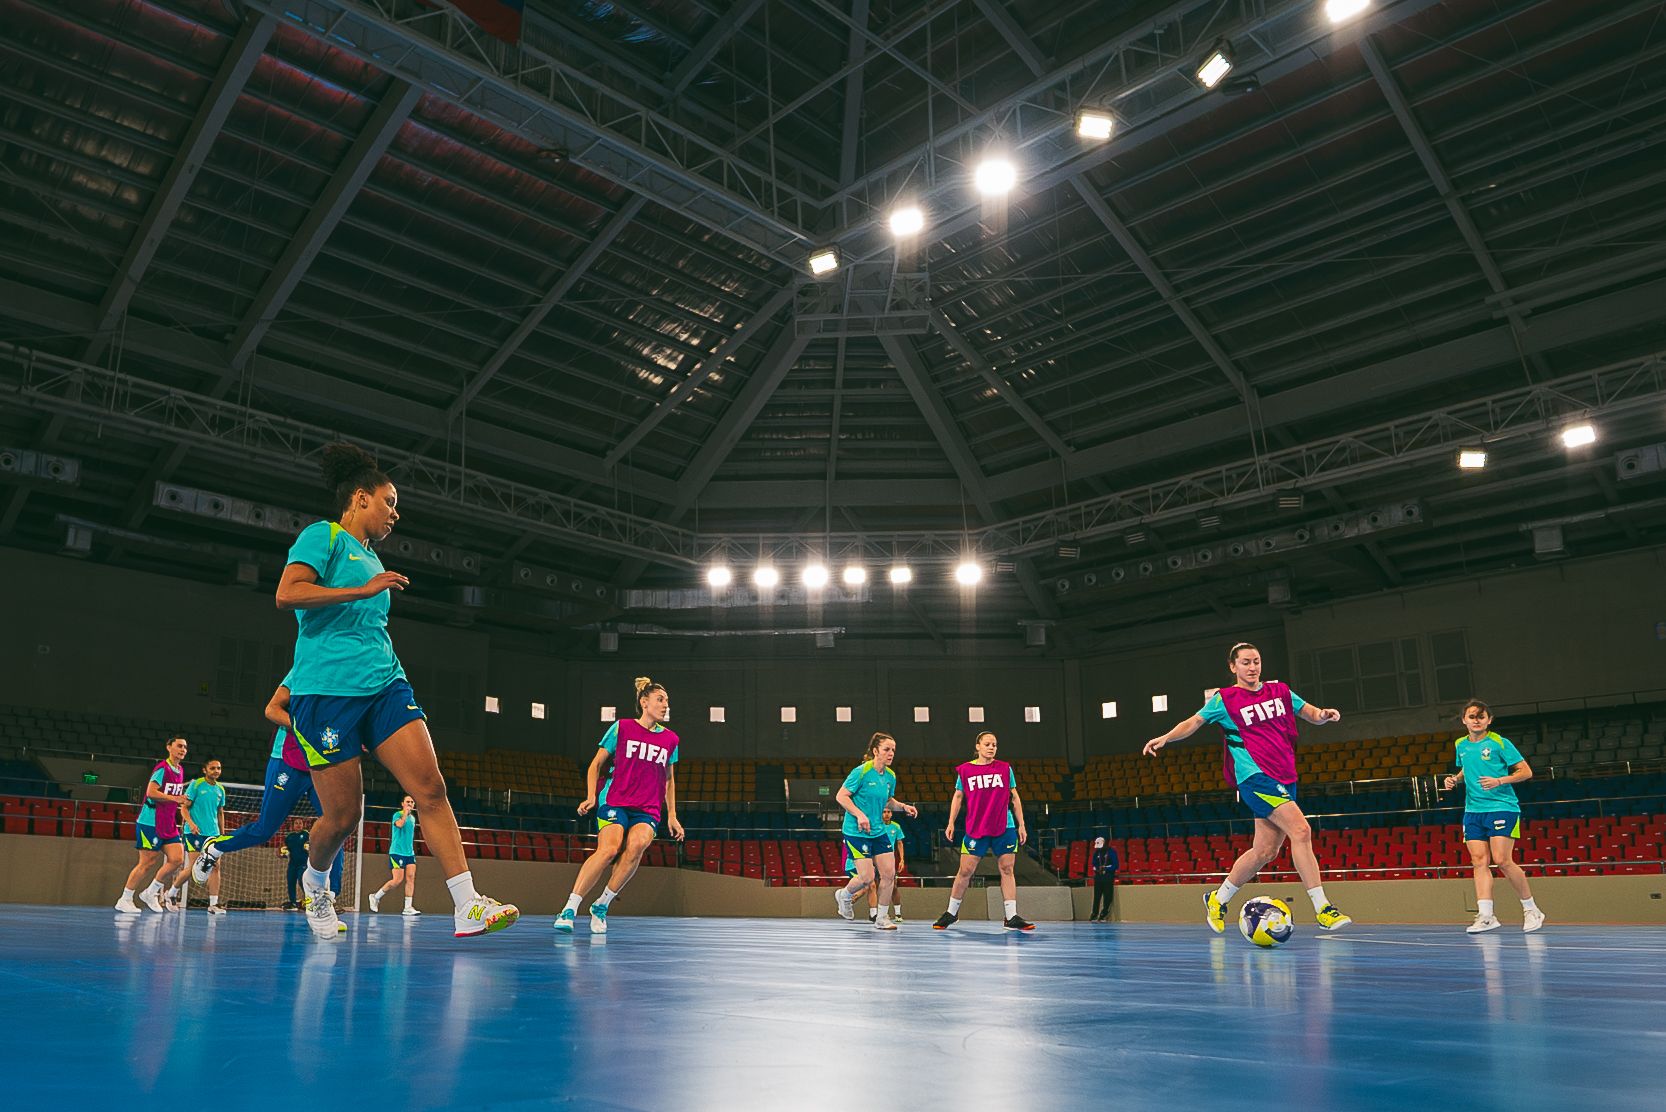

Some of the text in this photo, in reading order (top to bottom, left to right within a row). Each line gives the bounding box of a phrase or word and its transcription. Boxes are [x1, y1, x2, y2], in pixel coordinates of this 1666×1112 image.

[1239, 697, 1287, 726] FIFA
[626, 740, 668, 767] FIFA
[967, 773, 1004, 792] FIFA
